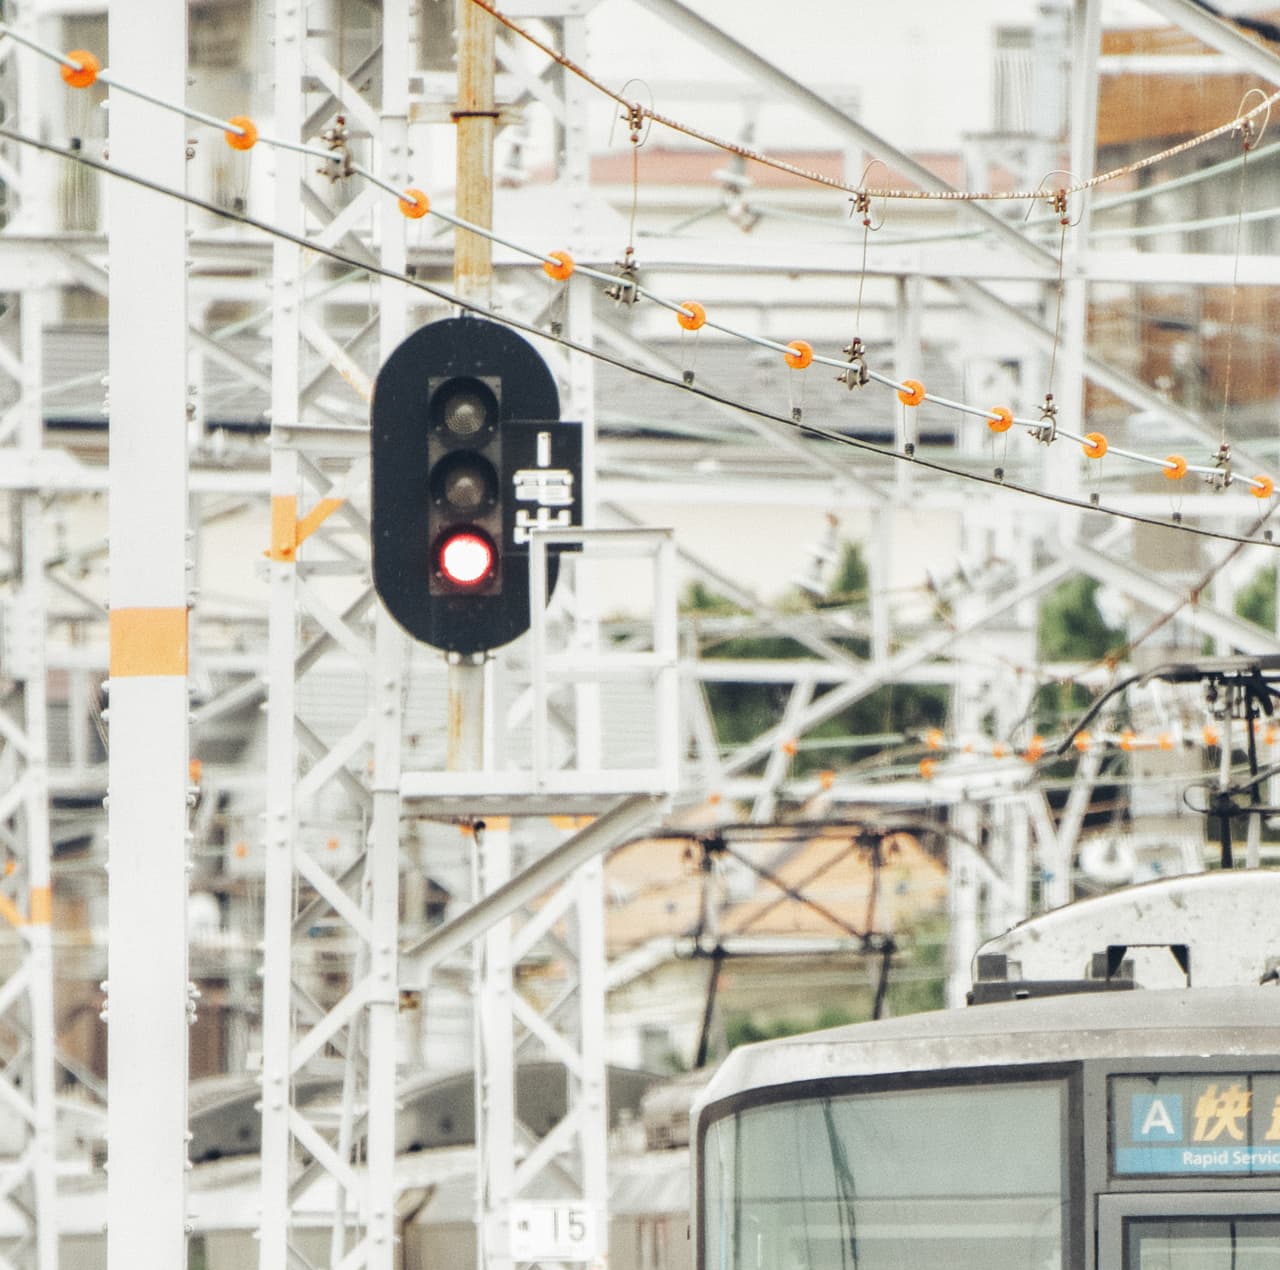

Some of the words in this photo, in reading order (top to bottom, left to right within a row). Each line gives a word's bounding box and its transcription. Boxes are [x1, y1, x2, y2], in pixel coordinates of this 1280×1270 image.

[1141, 1099, 1175, 1135] A
[1183, 1151, 1229, 1169] Rapid
[553, 1207, 586, 1243] 15
